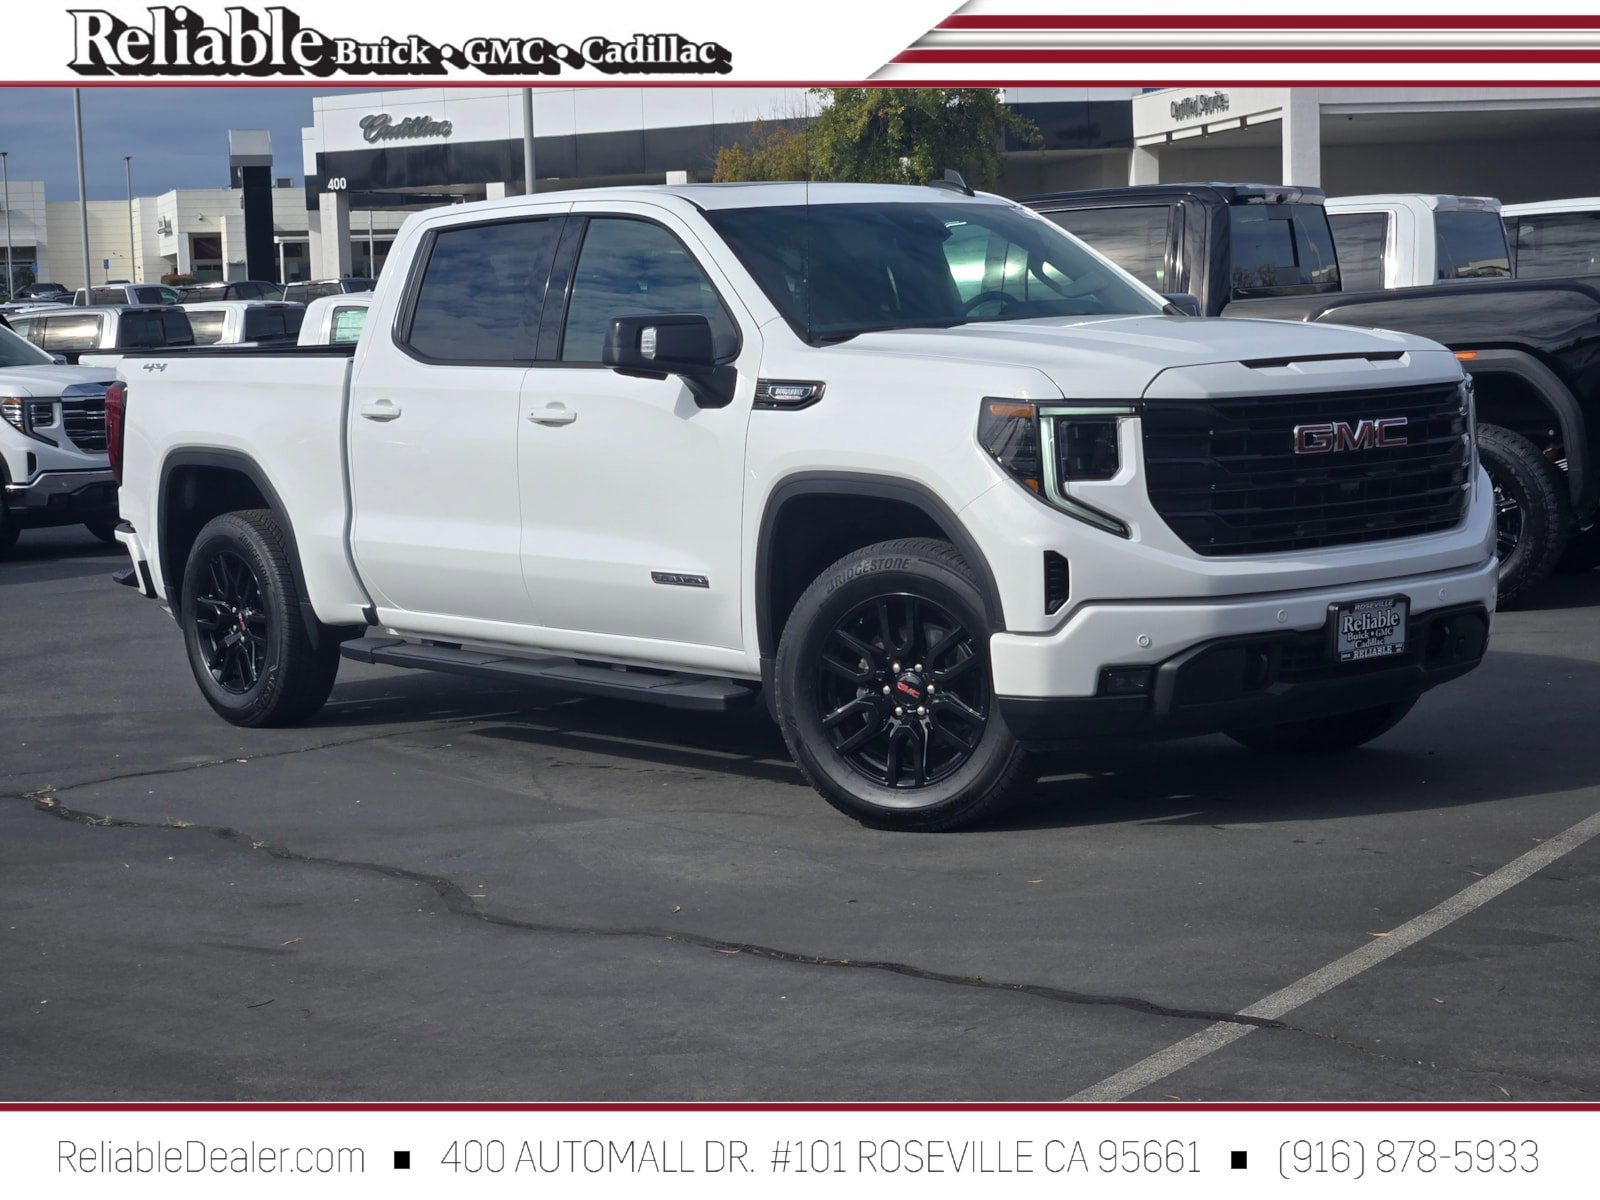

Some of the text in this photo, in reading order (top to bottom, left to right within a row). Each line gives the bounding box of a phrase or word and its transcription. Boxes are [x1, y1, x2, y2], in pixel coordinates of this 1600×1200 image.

[359, 114, 452, 144] Cadillac
[327, 177, 347, 190] 400
[1293, 417, 1408, 454] GMC
[826, 557, 911, 594] BRIDGESTONE
[1342, 609, 1399, 633] Reliable
[1347, 627, 1393, 641] Buick GMC
[1353, 645, 1392, 660] RELIABLE
